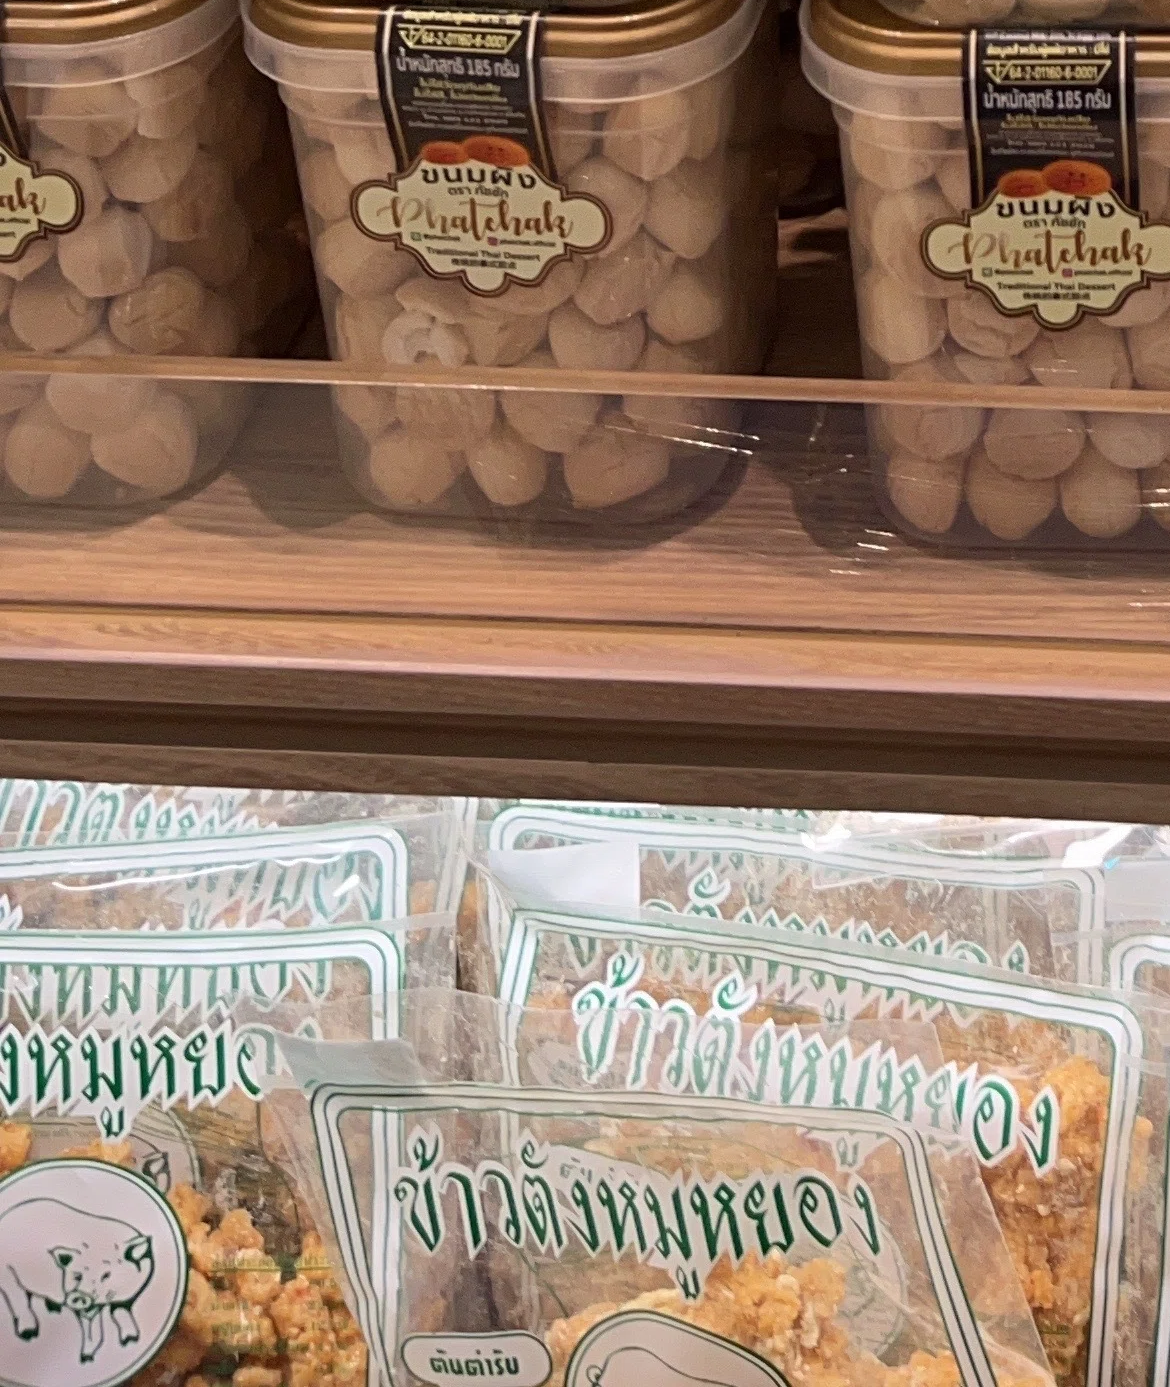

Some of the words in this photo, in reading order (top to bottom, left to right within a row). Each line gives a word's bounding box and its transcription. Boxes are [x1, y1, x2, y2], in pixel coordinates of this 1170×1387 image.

[466, 59, 492, 77] 185
[1056, 89, 1082, 108] 185
[421, 167, 535, 189] ขนมผิง
[997, 195, 1115, 217] ขนมผิง
[377, 197, 573, 240] Phatchak
[427, 247, 479, 257] Traditional
[481, 249, 502, 258] Thai
[948, 228, 1152, 273] Phatchak
[997, 282, 1050, 290] Traditional
[394, 1134, 880, 1298] ข้าวตังหมูหยอง
